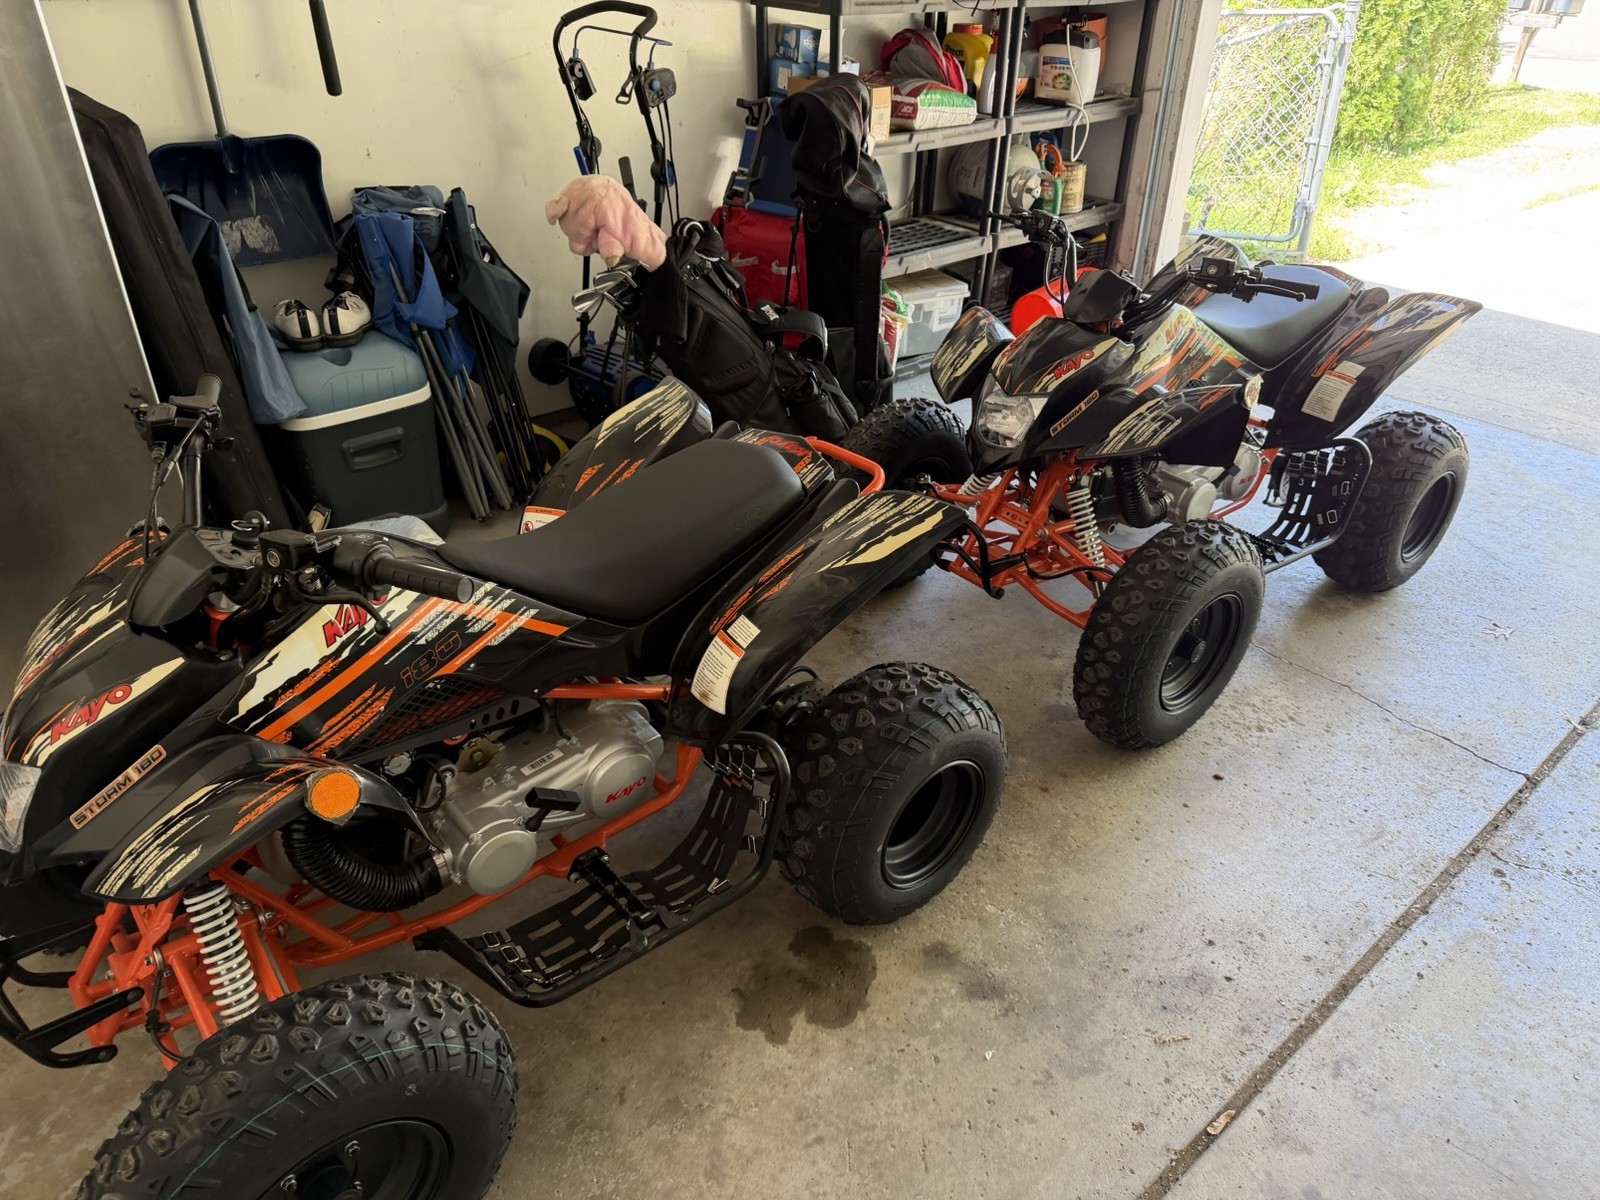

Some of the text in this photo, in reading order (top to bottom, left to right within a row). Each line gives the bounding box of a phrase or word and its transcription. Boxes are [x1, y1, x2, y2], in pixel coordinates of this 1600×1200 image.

[1053, 349, 1095, 380] KAYO
[1052, 406, 1083, 434] STORM
[50, 683, 133, 745] KAYO
[74, 748, 163, 825] STORM 180
[604, 776, 647, 804] KAYO
